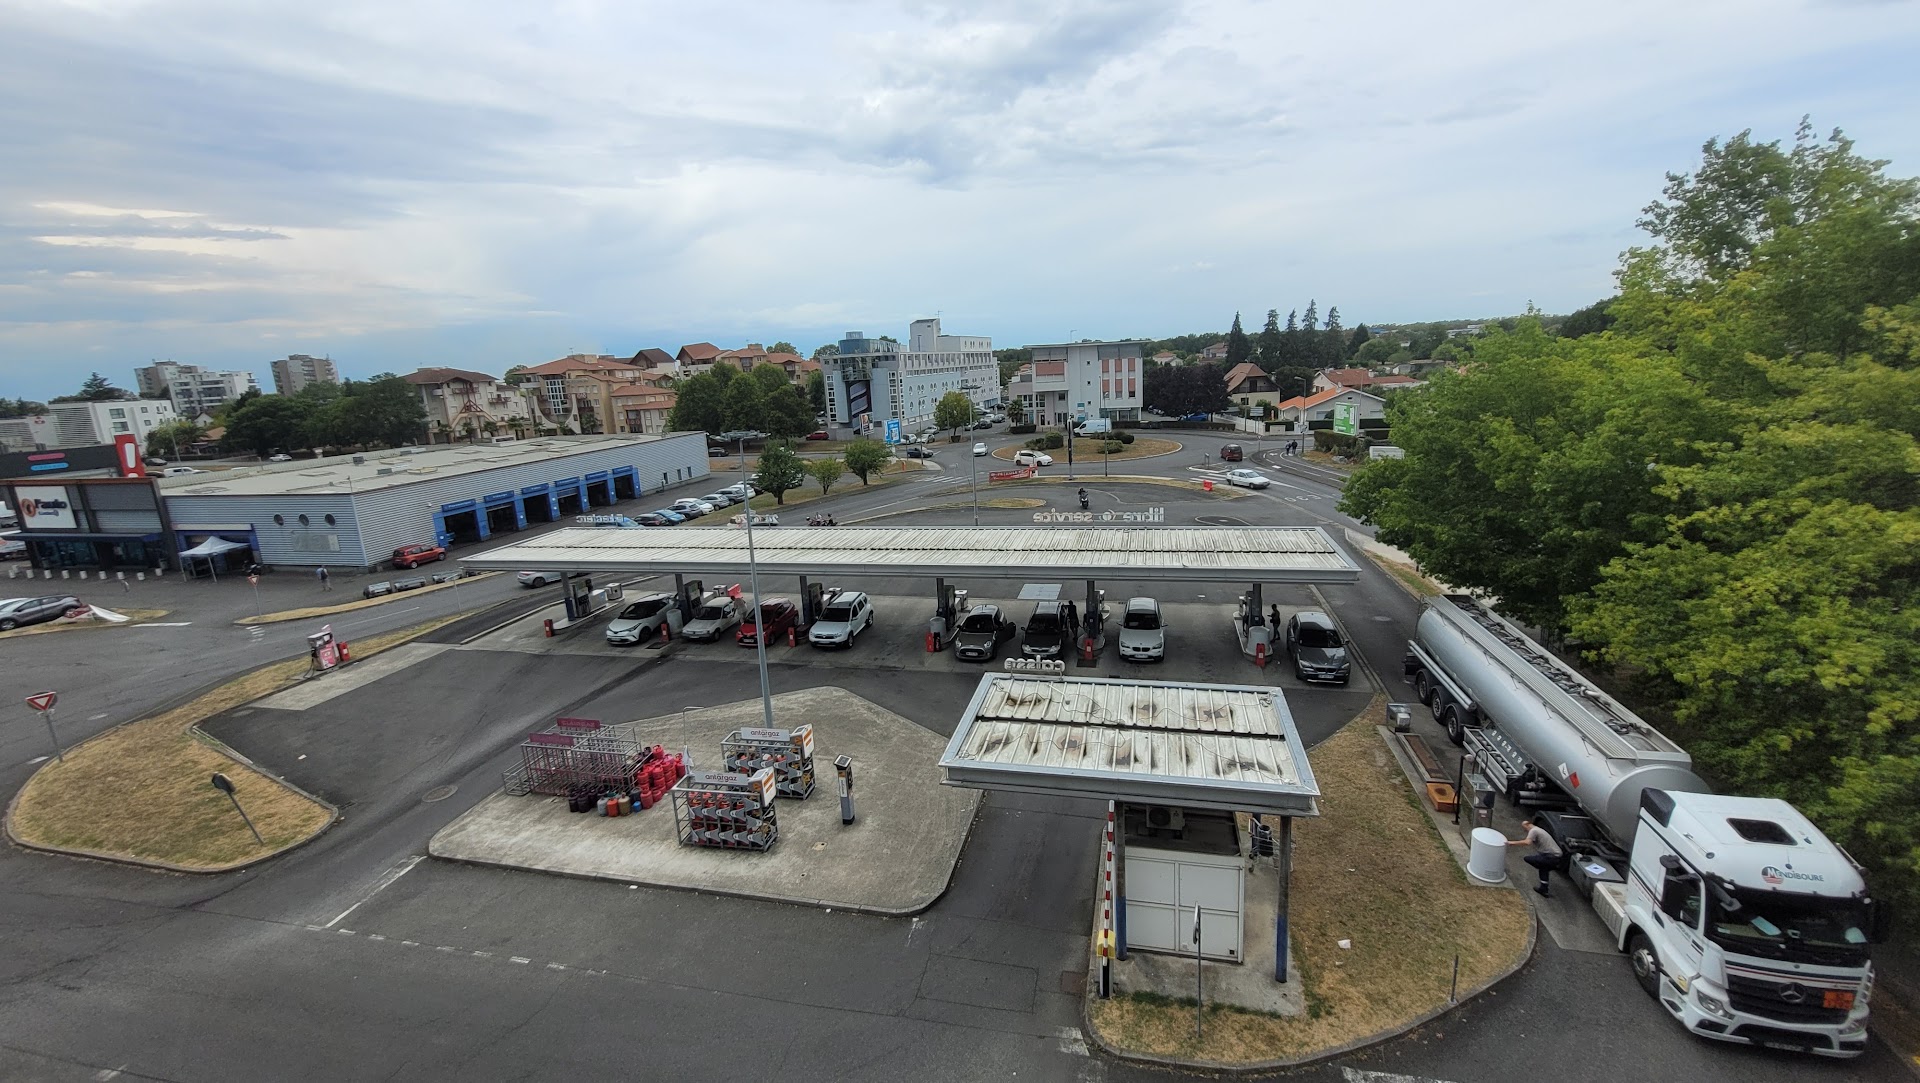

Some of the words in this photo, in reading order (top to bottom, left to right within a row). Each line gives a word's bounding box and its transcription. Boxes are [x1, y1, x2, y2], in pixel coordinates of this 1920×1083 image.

[750, 729, 780, 738] antargaz
[705, 773, 738, 783] antargaz
[1767, 867, 1825, 882] MENDIBOURE
